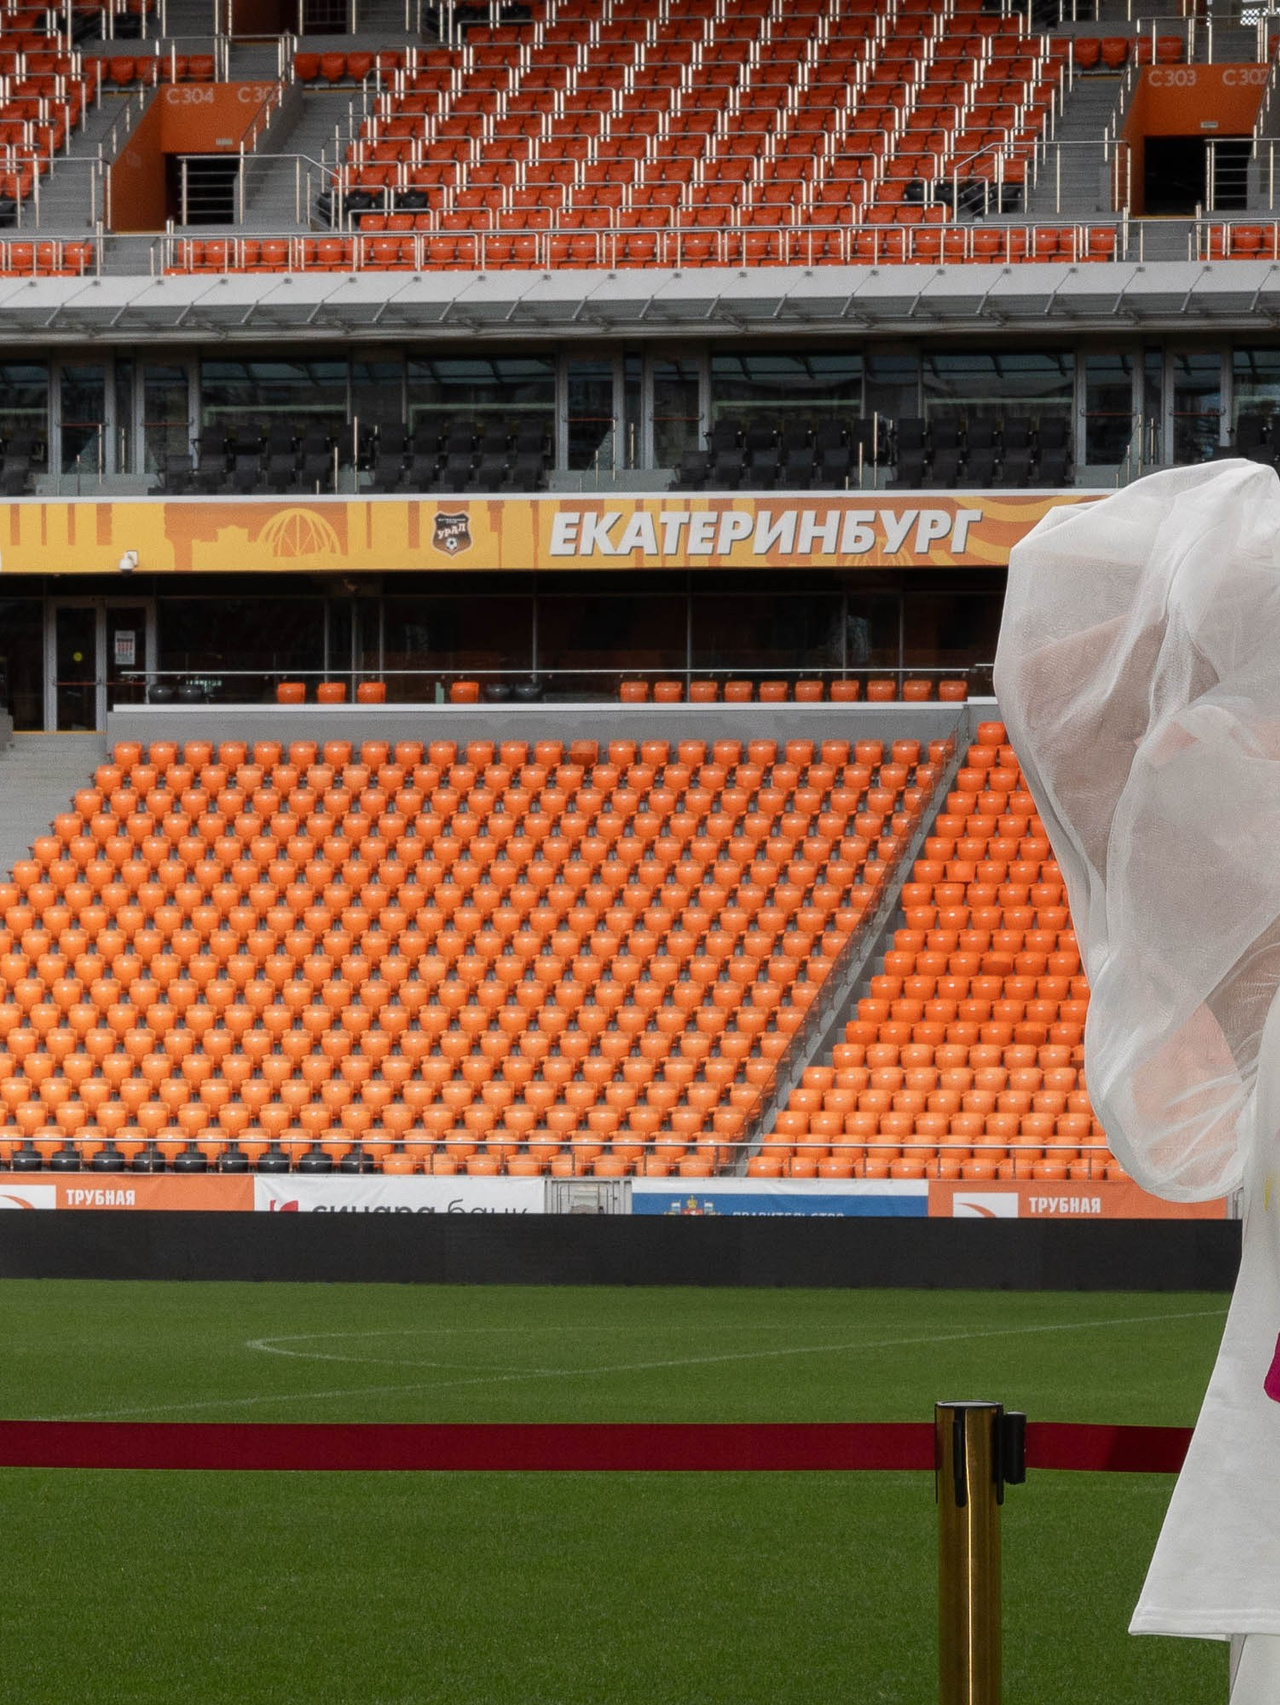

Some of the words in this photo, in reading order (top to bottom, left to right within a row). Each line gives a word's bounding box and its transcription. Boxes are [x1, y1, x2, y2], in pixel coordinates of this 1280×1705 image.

[548, 509, 983, 557] ЕКАТЕРИНБУРГ
[66, 1189, 136, 1206] ТРУБНАЯ
[1029, 1197, 1102, 1214] ТРУБНАЯ
